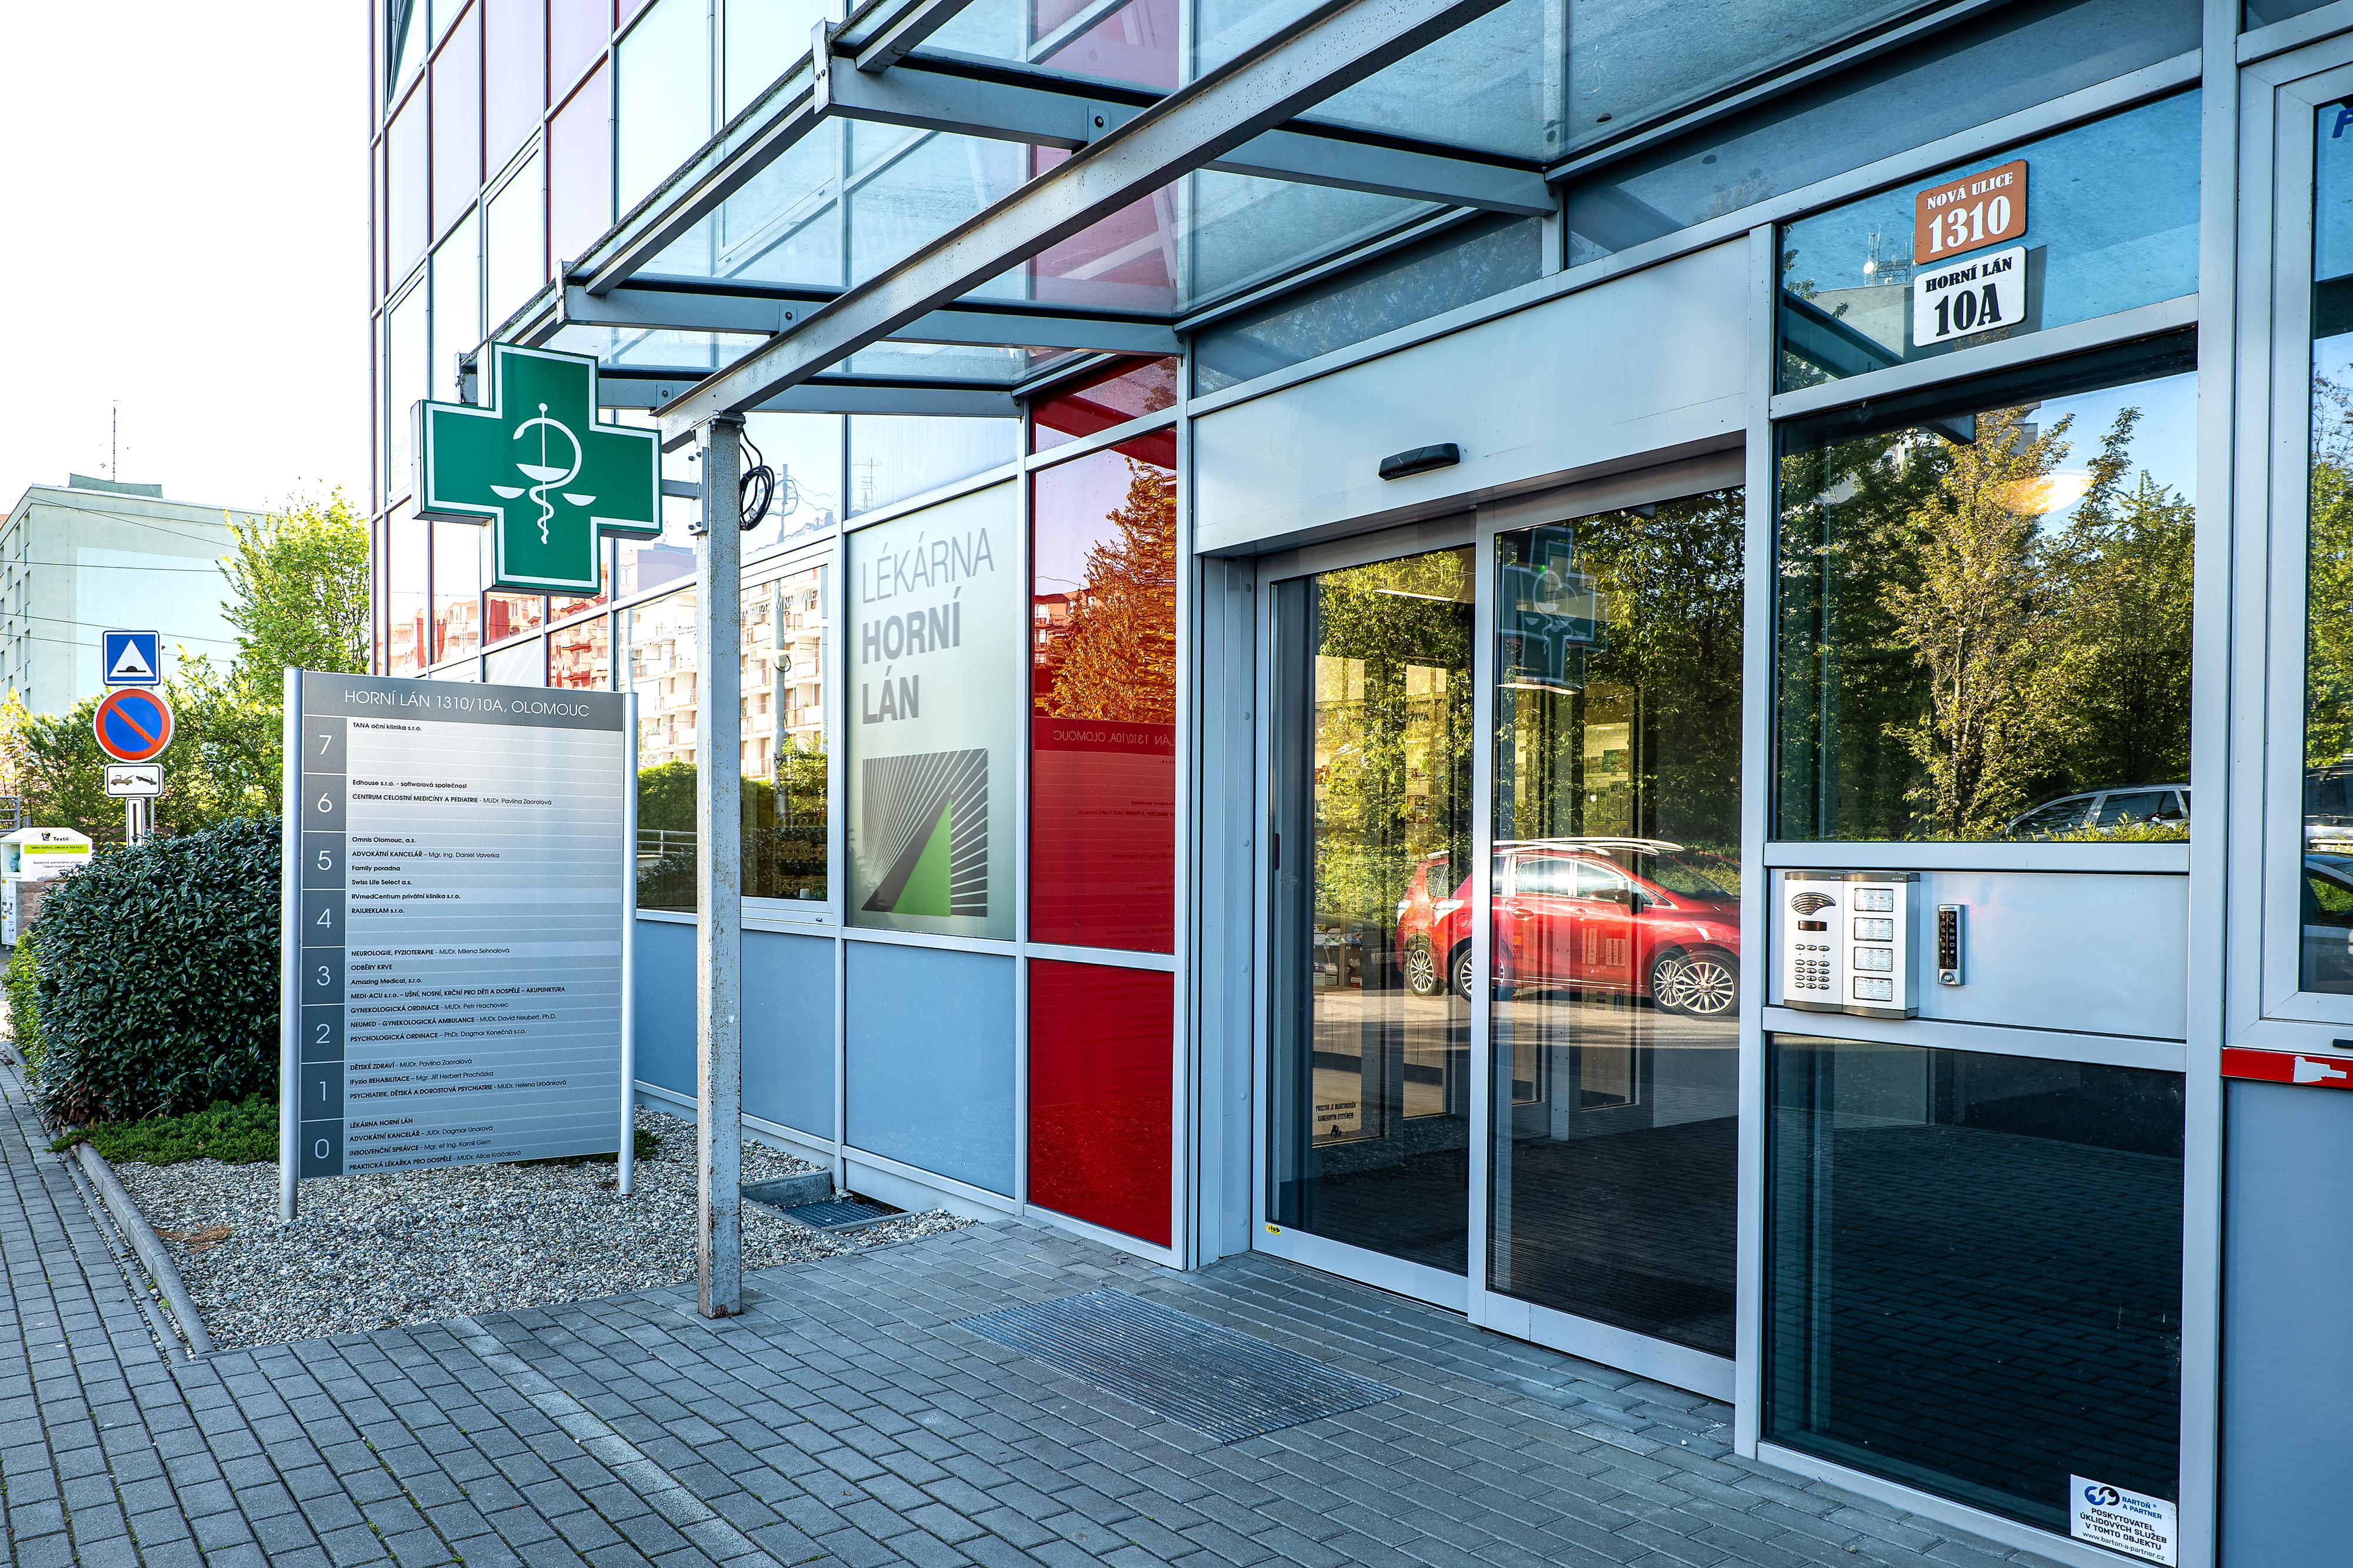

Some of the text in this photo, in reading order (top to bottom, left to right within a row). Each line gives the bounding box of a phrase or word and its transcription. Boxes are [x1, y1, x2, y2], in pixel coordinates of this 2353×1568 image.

[1927, 172, 2013, 211] NOVÁ ULICE
[1928, 195, 2011, 253] 1310
[1925, 256, 2013, 293] HORNÍ LÁN
[1934, 283, 2002, 336] 10A
[863, 528, 995, 604] LÉKÁRNA
[862, 586, 961, 664] HORNÍ
[345, 690, 589, 716] HORNÍ LÁN 1310/10A, OLOMOUC
[862, 665, 919, 725] LÁN
[319, 735, 332, 755] 7
[318, 792, 332, 813] 6
[413, 794, 444, 802] MEDICÍNY
[317, 850, 332, 870] 5
[316, 908, 331, 928] 4
[316, 965, 331, 986] 3
[350, 963, 376, 971] ODBĚRY
[404, 989, 421, 998] UŠNÍ,
[421, 989, 443, 997] NOSNÍ,
[444, 988, 464, 996] KRČNÍ
[495, 986, 521, 994] DOSPĚLÉ
[350, 1004, 406, 1014] GYNEKOLOGICKÁ
[381, 1016, 437, 1026] GYNEKOLOGICKÁ
[316, 1023, 330, 1044] 2
[350, 1032, 405, 1042] PSYCHOLOGICKÁ
[405, 1032, 438, 1040] ORDINACE
[349, 1062, 372, 1071] DĚTSKÉ
[372, 1060, 395, 1069] ZDRAVÍ
[441, 1057, 472, 1066] Zaoralová
[349, 1090, 389, 1099] PSYCHIATRIE,
[389, 1087, 412, 1096] DĚTSKÁ
[419, 1085, 457, 1095] DOROSTOVÁ
[457, 1083, 493, 1092] PSYCHIATRIE
[536, 1079, 566, 1087] Urbánková
[368, 1075, 410, 1084] REHABILITACE
[319, 1081, 326, 1101] 1
[349, 1116, 413, 1129] LÉKÁRNA HORNÍ LÁN
[348, 1132, 387, 1142] ADVOKÁTNÍ
[387, 1129, 420, 1139] KANCELÁŘ
[315, 1138, 329, 1159] 0
[349, 1145, 392, 1156] INSOLVENČNÍ
[391, 1144, 419, 1153] SPRÁVCE
[348, 1160, 384, 1170] PRAKTICKÁ
[384, 1159, 412, 1167] LÉKAŘKA
[426, 1154, 452, 1163] DOSPĚLÉ
[2122, 1496, 2151, 1509] BARTOŇ
[2129, 1505, 2162, 1520] PARTNER
[2079, 1512, 2167, 1544] ÚKLIDOVÝCH SLUŽEB
[2091, 1507, 2155, 1532] POSKYTOVATEL
[2082, 1532, 2165, 1561] www.barton-a-partner.cz
[2093, 1524, 2121, 1538] TOMTO
[2123, 1534, 2161, 1550] OBJEKTU
